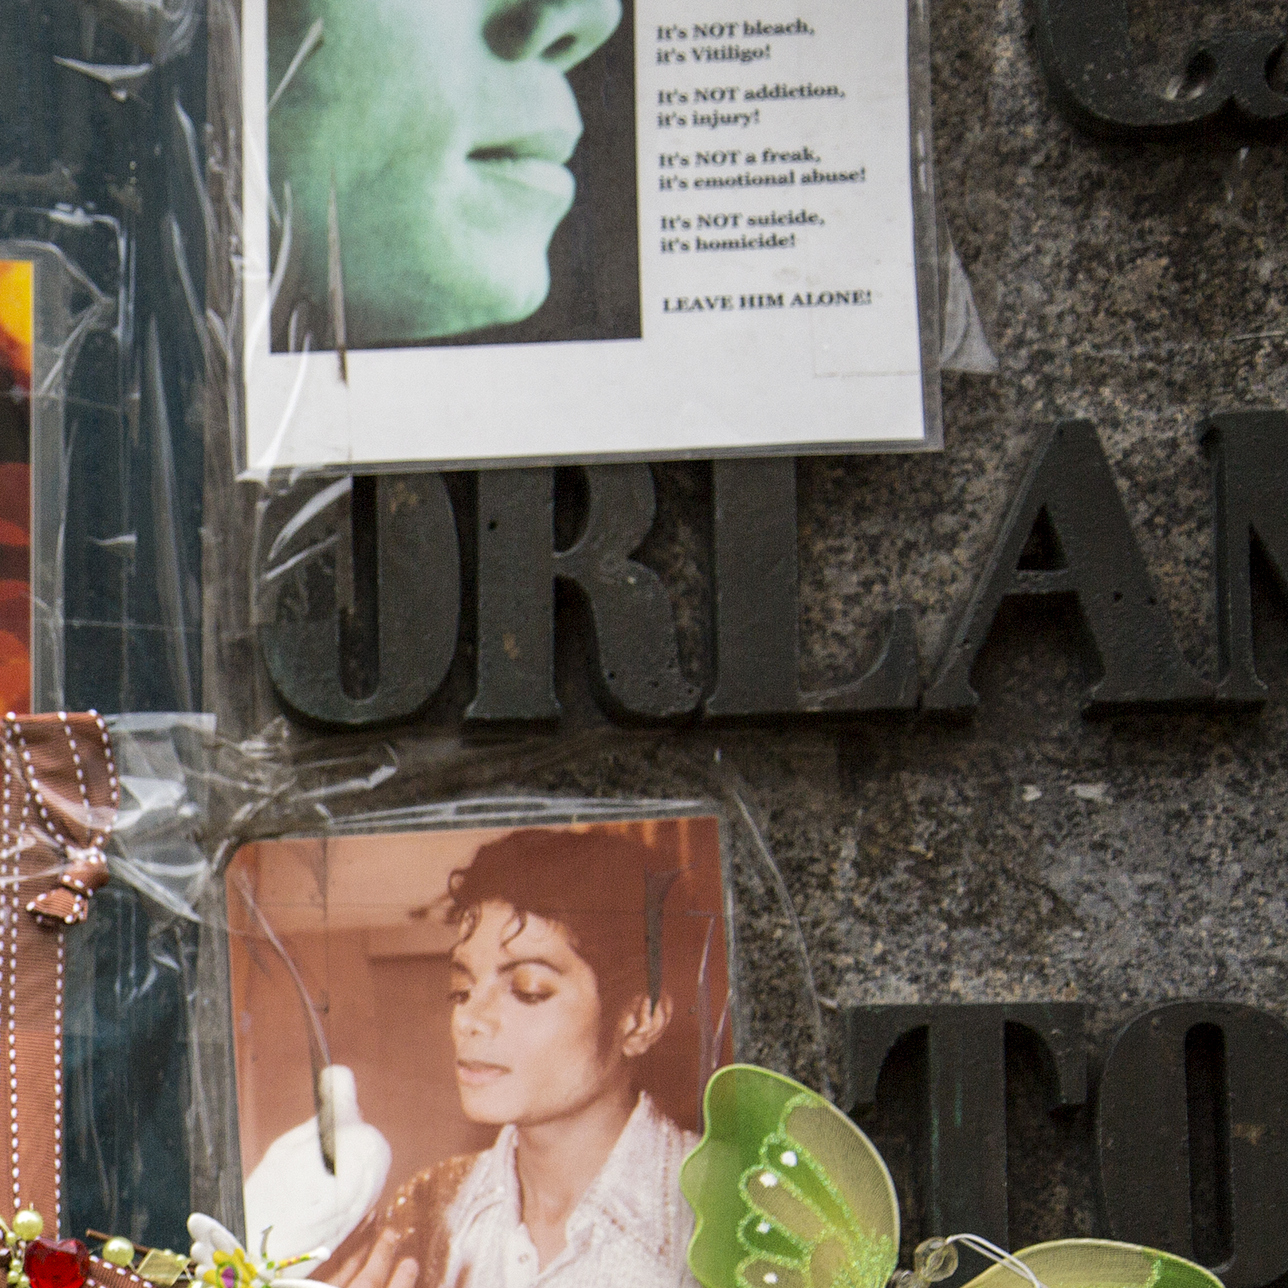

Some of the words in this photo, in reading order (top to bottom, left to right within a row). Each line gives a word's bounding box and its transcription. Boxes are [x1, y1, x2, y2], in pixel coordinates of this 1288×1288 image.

[657, 25, 687, 41] It's
[693, 23, 738, 37] NOT
[743, 18, 814, 35] bleach,
[656, 50, 686, 64] it's
[692, 45, 770, 64] Vitiligo!
[658, 90, 688, 105] It's
[694, 87, 737, 101] NOT
[744, 83, 845, 101] addiction,
[657, 113, 687, 128] it's
[692, 110, 759, 129] injury!
[659, 153, 689, 168] It's
[696, 151, 740, 164] NOT
[745, 154, 756, 164] a
[762, 147, 820, 163] freak,
[659, 177, 688, 191] it's
[693, 172, 795, 189] emotional
[801, 167, 866, 185] abuse!
[661, 216, 691, 231] It's
[697, 214, 740, 227] NOT
[747, 209, 825, 226] suicide,
[661, 239, 690, 253] it's
[695, 234, 795, 251] homicide!
[663, 296, 732, 313] LEAVE
[740, 294, 784, 309] HIM
[791, 290, 871, 307] ALONE!
[262, 405, 1288, 728] ORLA
